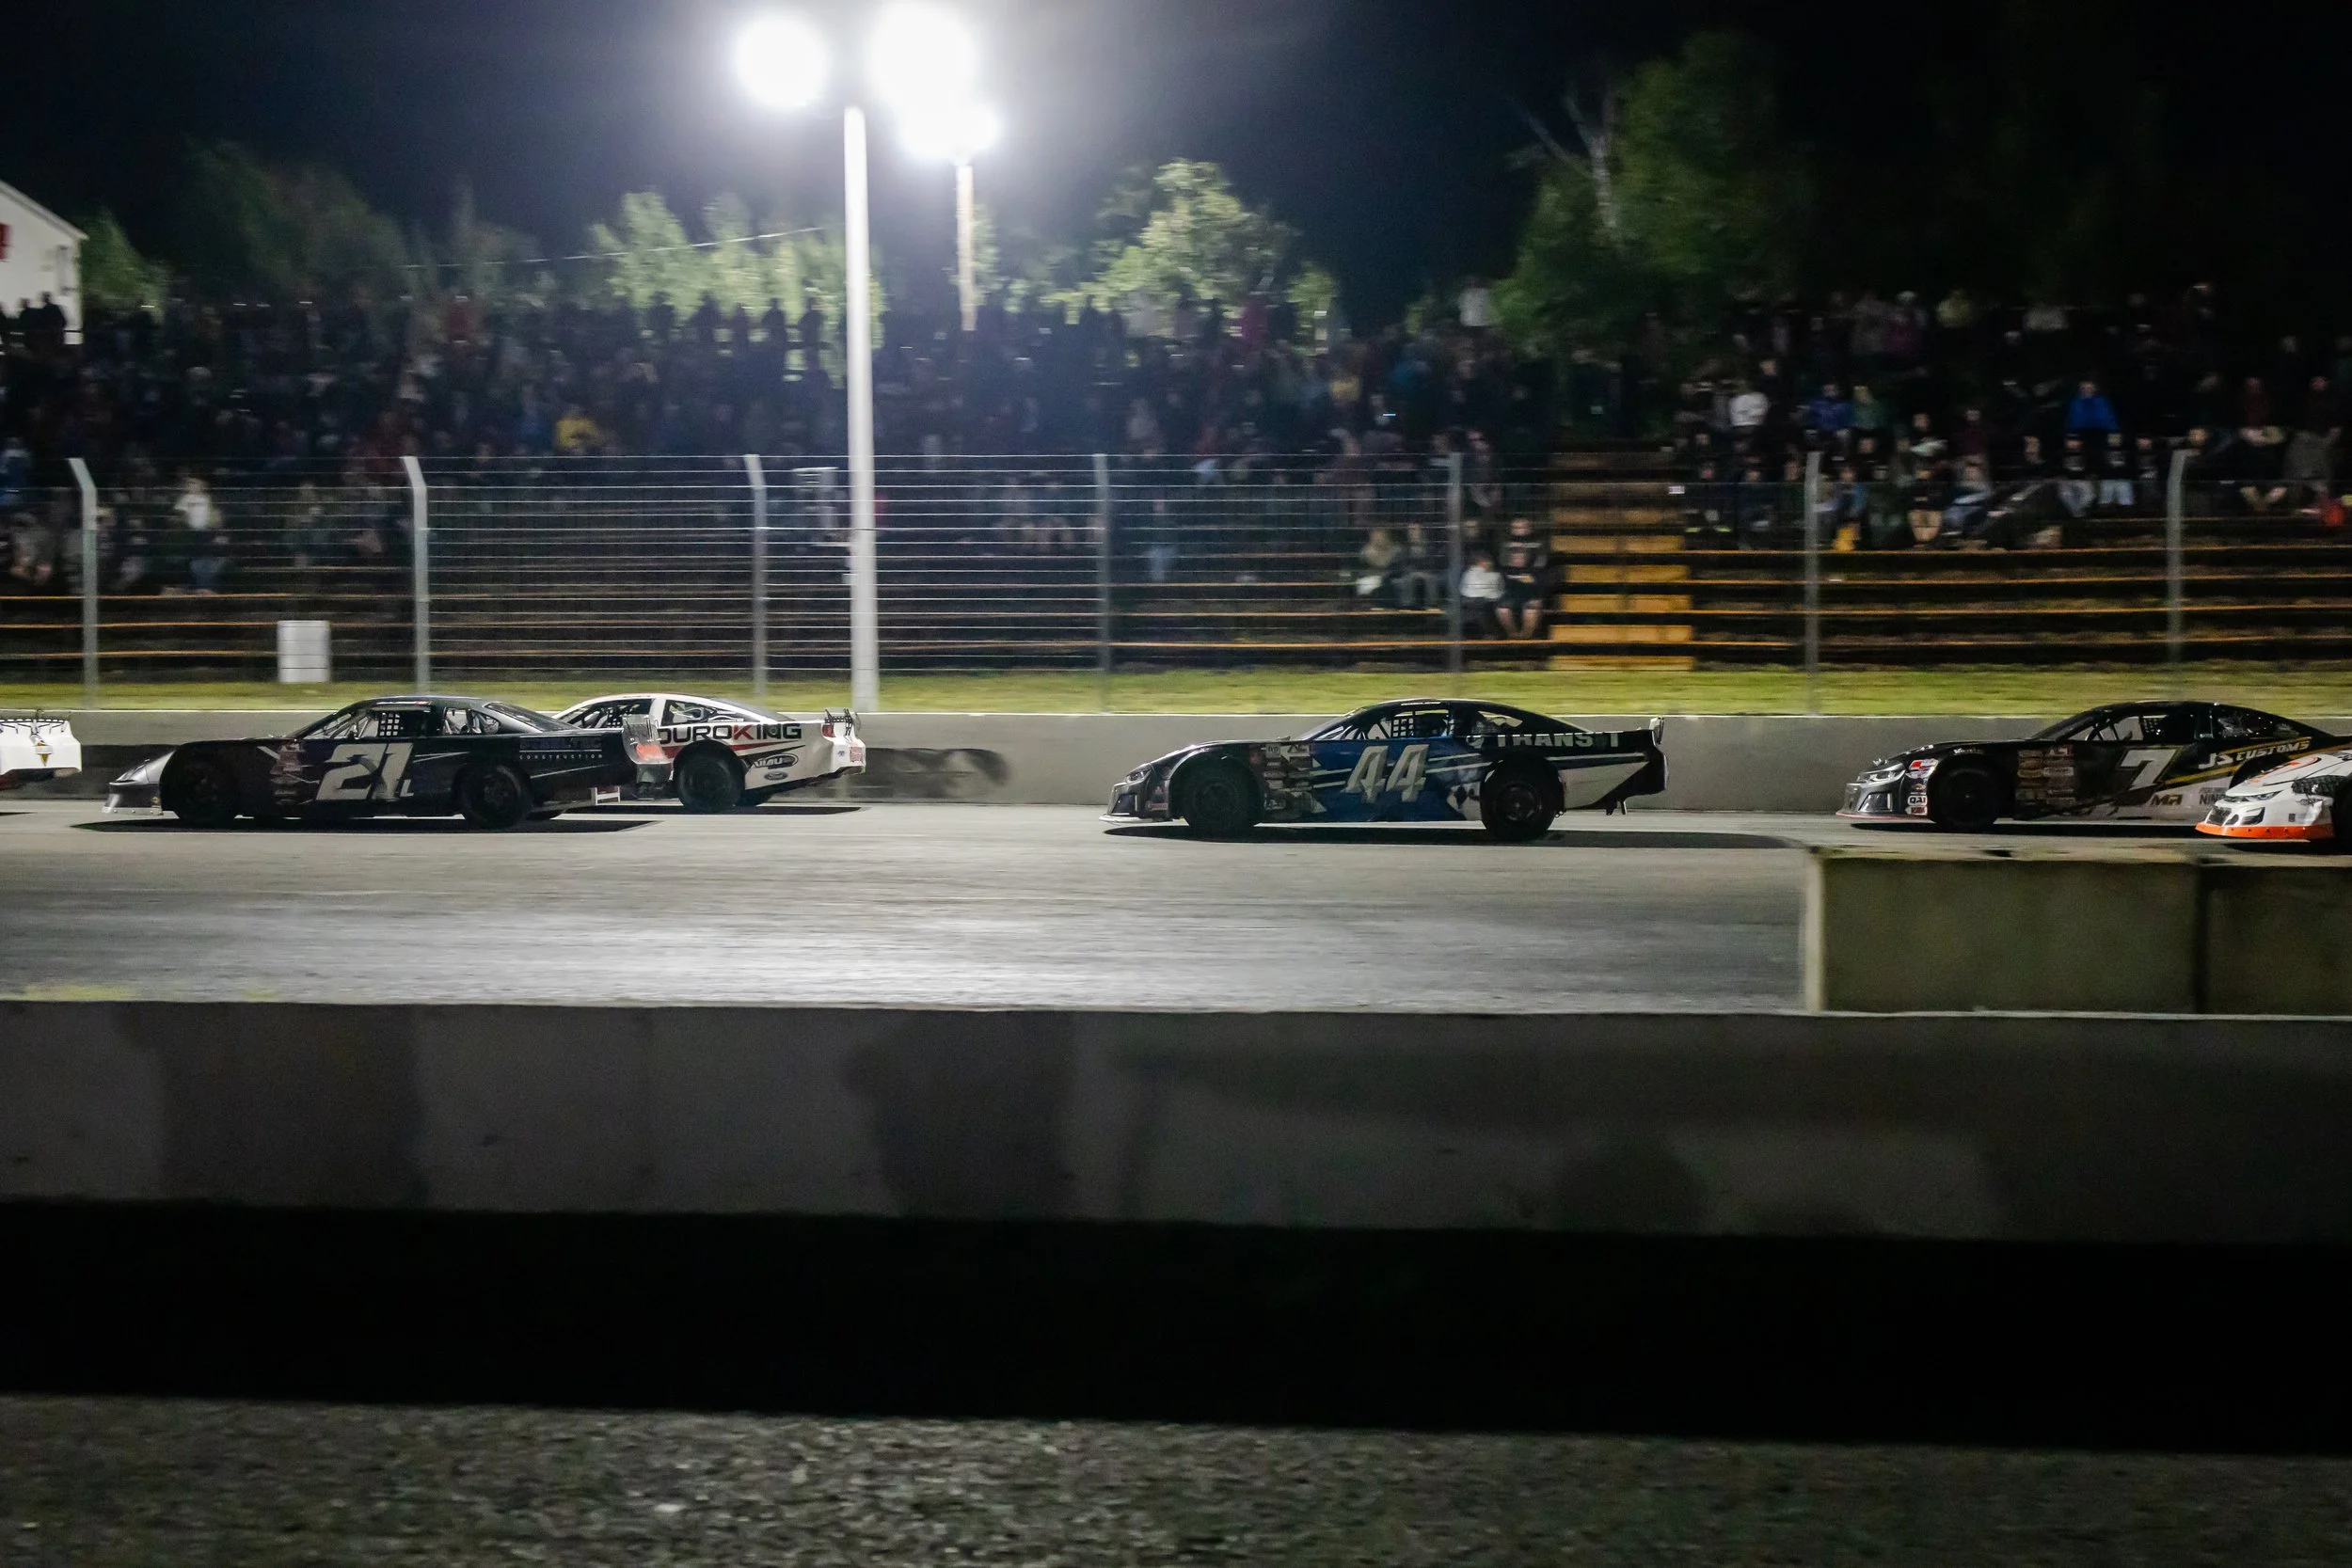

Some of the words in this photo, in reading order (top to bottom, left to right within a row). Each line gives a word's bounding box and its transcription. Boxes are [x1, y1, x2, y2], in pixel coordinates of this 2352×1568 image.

[657, 723, 802, 745] DUROKING
[1496, 732, 1620, 748] TRANST
[2198, 752, 2233, 769] JS
[2235, 740, 2312, 762] CUSTOMS
[1340, 744, 1430, 803] 44
[2118, 748, 2179, 791] 7
